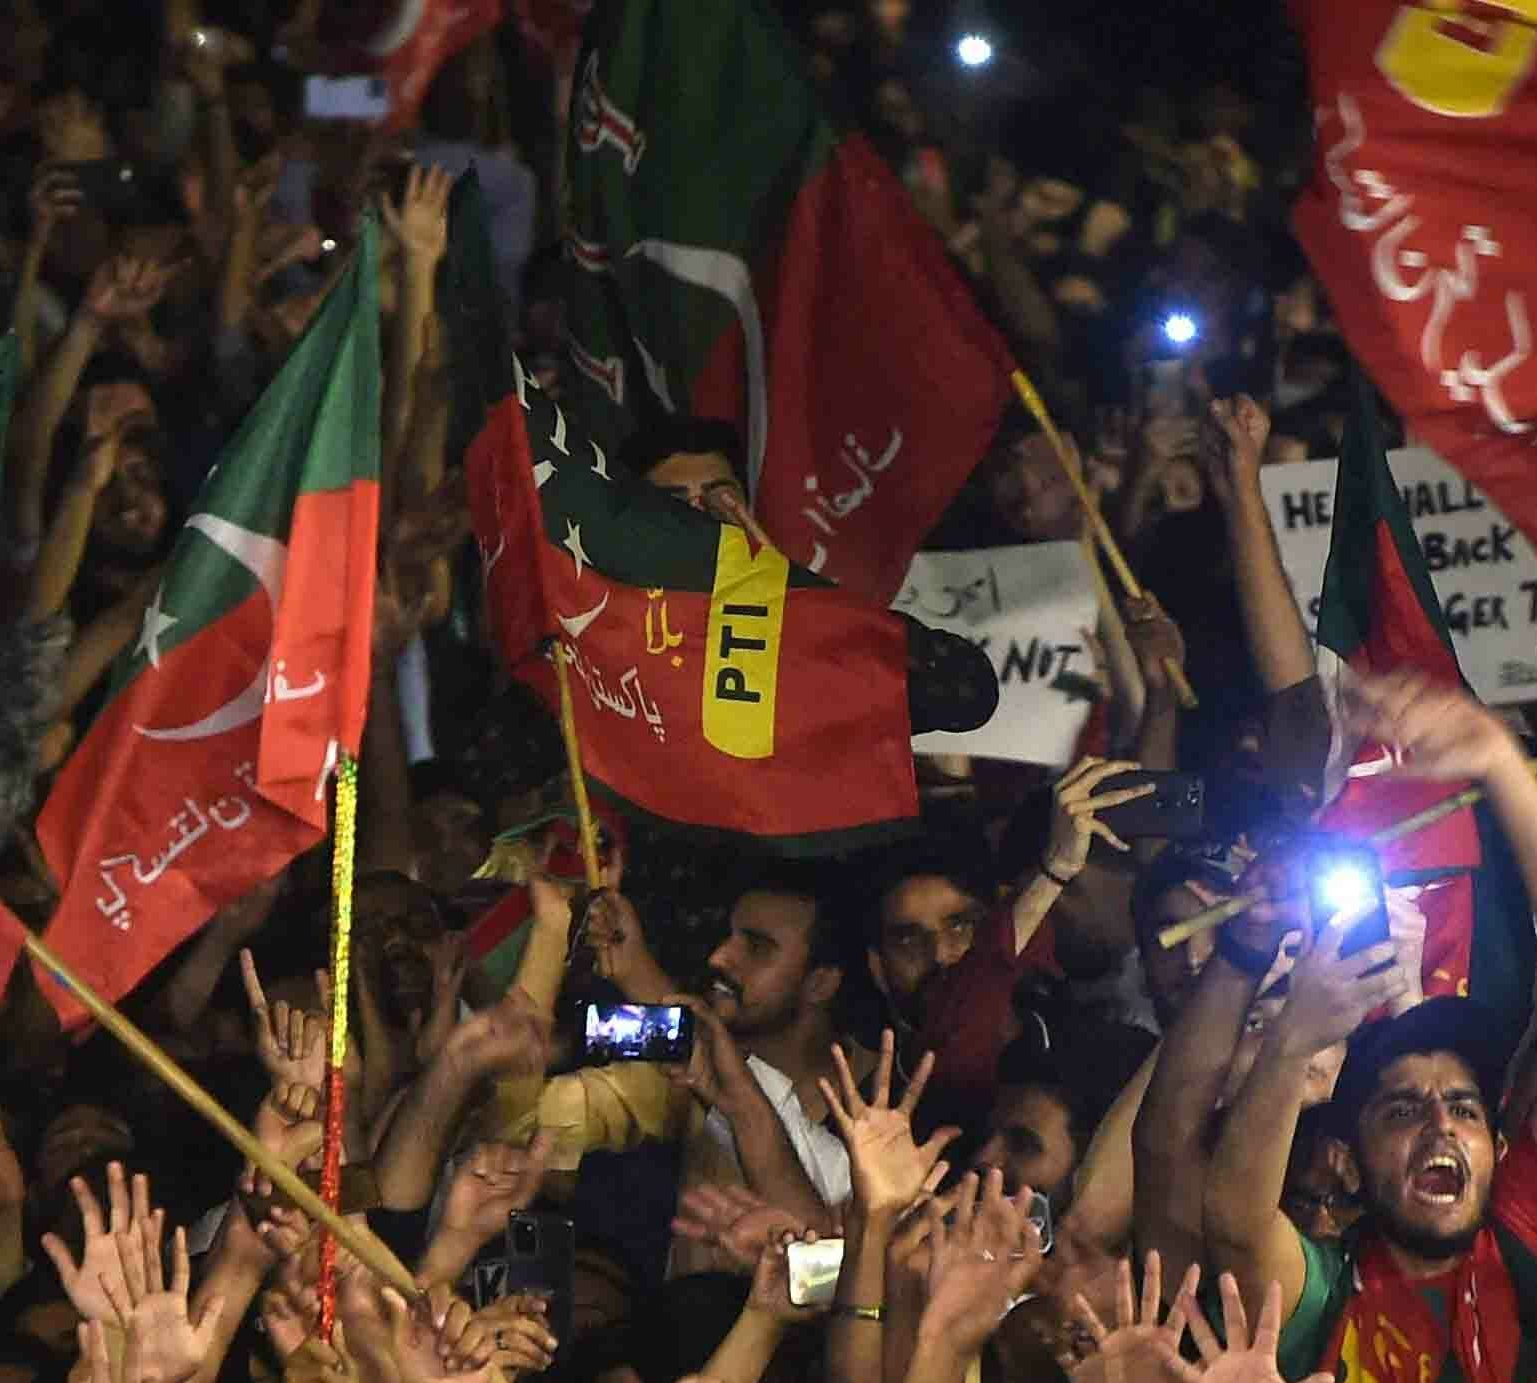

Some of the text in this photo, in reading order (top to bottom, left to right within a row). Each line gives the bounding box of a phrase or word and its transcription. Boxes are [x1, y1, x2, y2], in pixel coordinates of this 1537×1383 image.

[1283, 489, 1331, 528] HE
[716, 603, 768, 704] PTI
[1001, 636, 1083, 685] NOT
